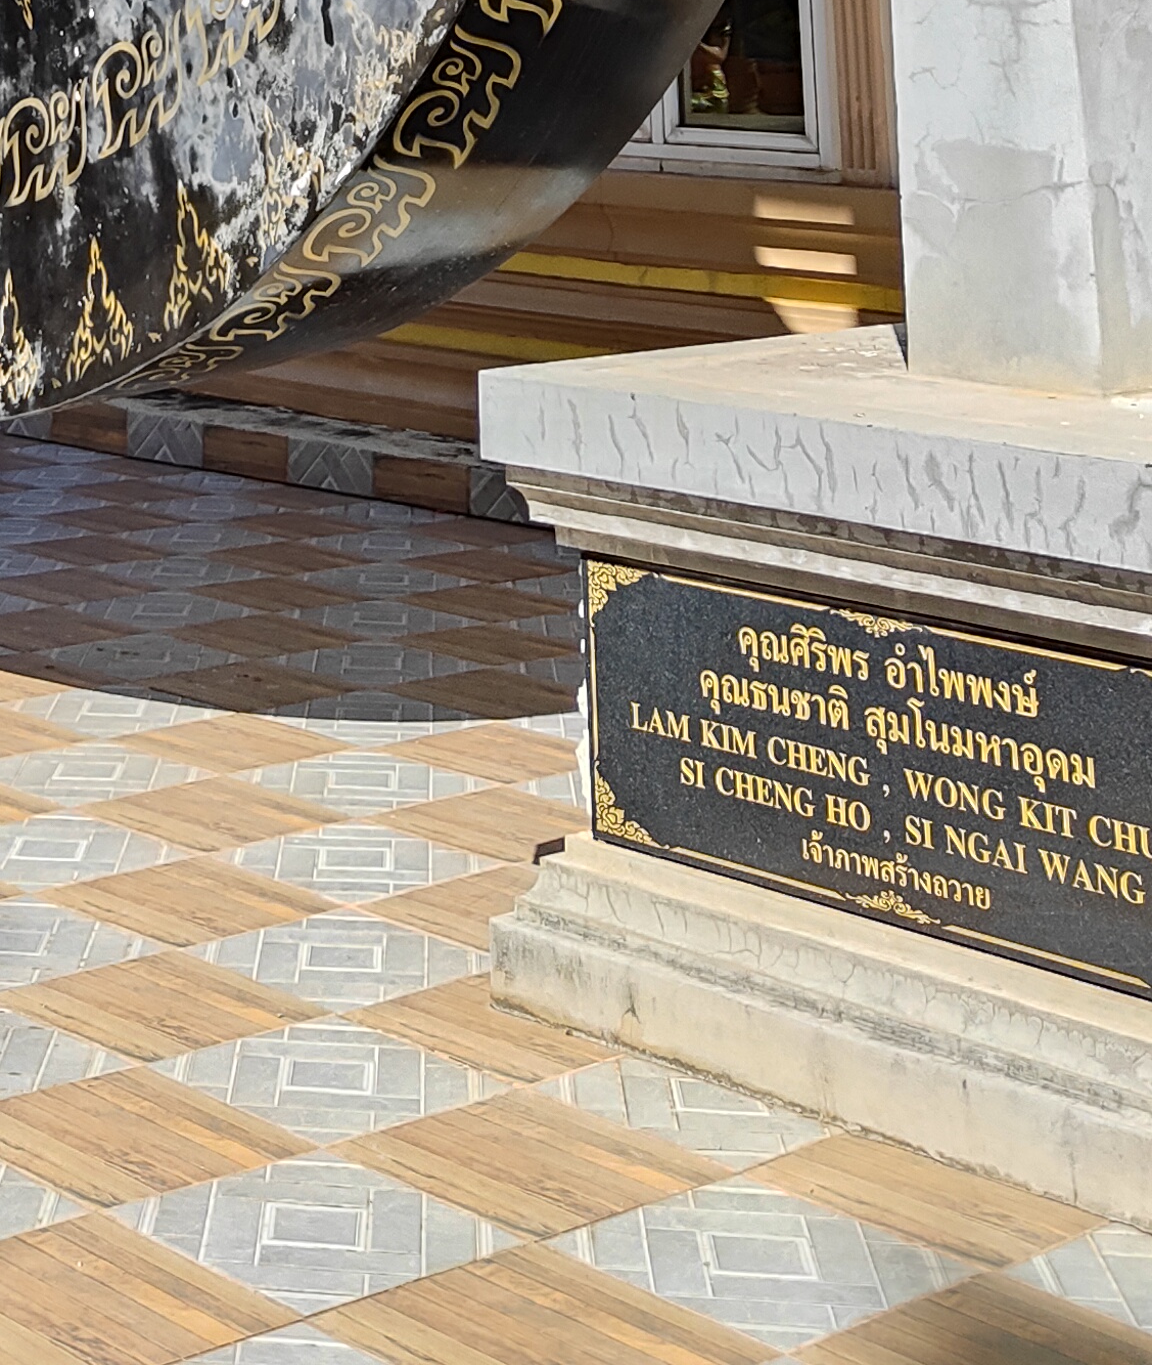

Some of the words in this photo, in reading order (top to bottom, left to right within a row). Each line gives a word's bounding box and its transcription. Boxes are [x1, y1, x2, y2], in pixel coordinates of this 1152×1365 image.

[700, 668, 850, 731] คุณธนชาติ
[864, 697, 1096, 794] สุมโนมหาอุดม
[738, 623, 870, 681] คุณศิริพร
[884, 643, 1039, 718] อำไพพงษ์
[630, 701, 692, 743] LAM
[700, 719, 758, 759] KIM
[767, 736, 871, 787] CHENG
[903, 768, 1006, 820] WONG
[1018, 795, 1078, 839] KIT
[680, 757, 706, 789] SI
[715, 767, 817, 817] CHENG
[825, 793, 872, 832] HO
[904, 815, 935, 850] SI
[944, 824, 1028, 875] NGAI
[1037, 848, 1146, 905] WANG
[801, 830, 991, 910] เจ้าภาพสร้างถวาย
